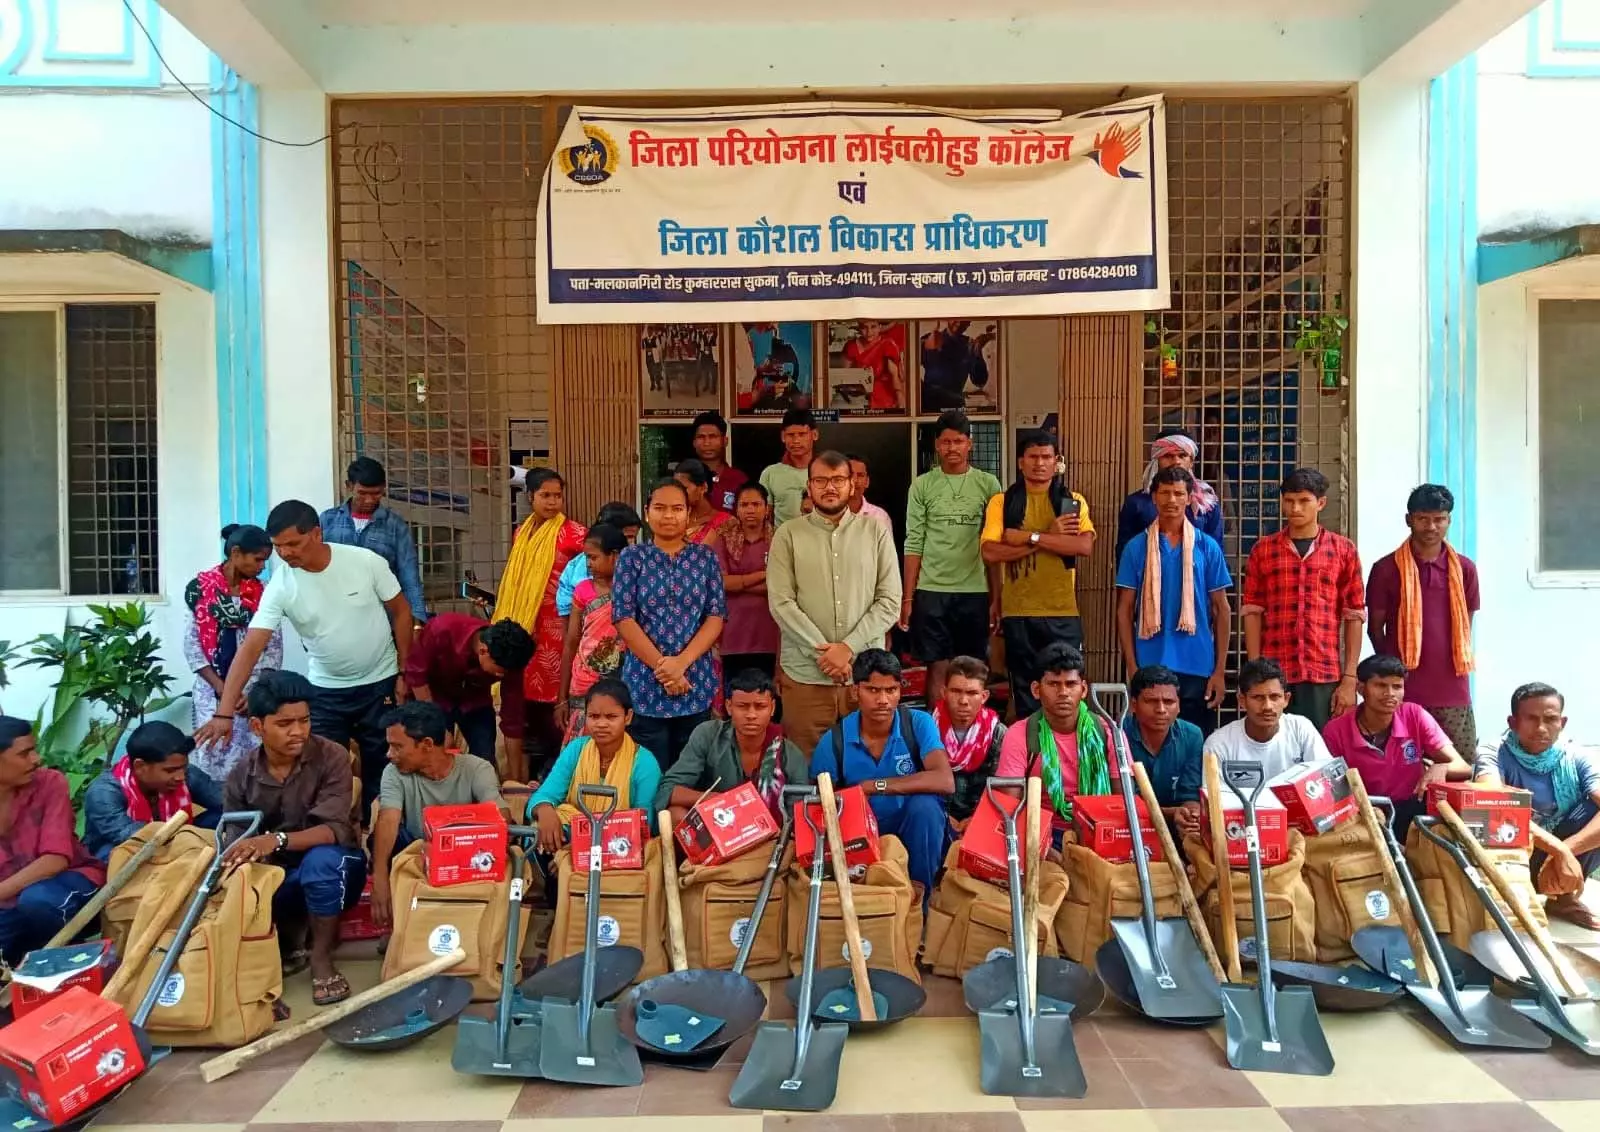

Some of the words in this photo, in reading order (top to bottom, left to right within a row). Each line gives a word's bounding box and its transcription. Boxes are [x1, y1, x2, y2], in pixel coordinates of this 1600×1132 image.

[629, 130, 699, 167] जिला
[707, 128, 837, 166] परियोजना
[845, 126, 980, 176] लाईवलीहुड
[988, 129, 1074, 165] कॉलेज
[838, 171, 867, 204] एवं
[658, 219, 728, 256] जिला
[736, 216, 821, 254] कौशल
[829, 215, 915, 252] विकास
[924, 214, 1048, 250] प्राधिकरण
[664, 274, 683, 290] रोड
[684, 277, 742, 293] कुम्हाररास
[787, 271, 809, 287] पिन
[989, 267, 1014, 283] फोन
[1015, 269, 1048, 283] नम्बर
[1058, 264, 1137, 281] 07864284018
